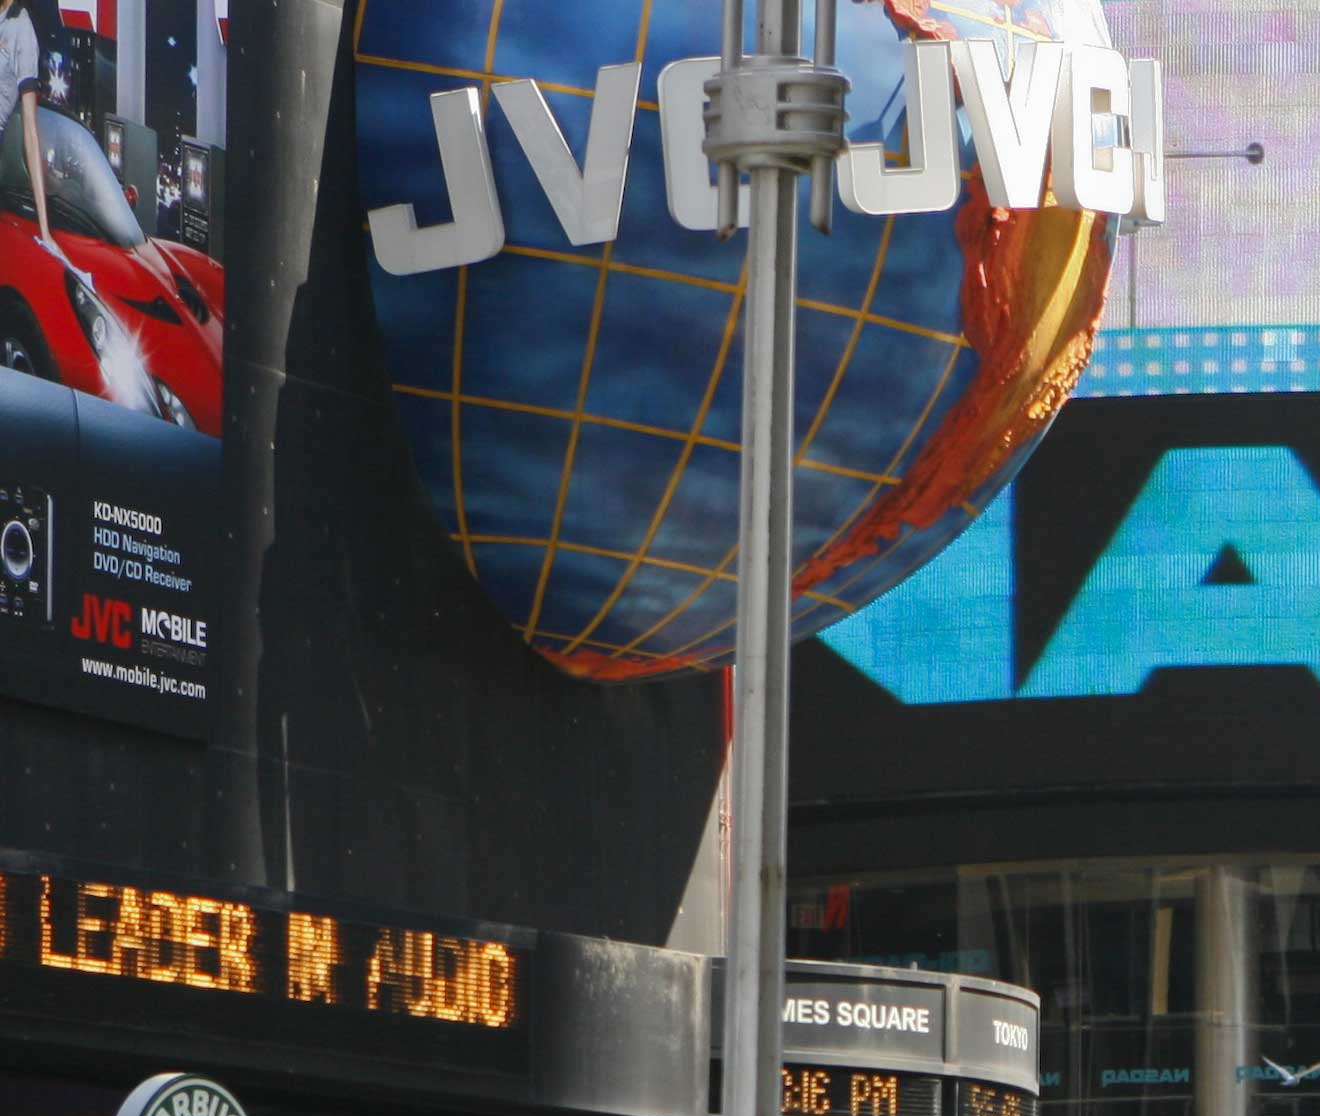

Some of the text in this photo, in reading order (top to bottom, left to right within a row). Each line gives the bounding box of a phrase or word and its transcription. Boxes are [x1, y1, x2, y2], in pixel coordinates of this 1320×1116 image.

[838, 39, 1135, 216] JVC
[93, 500, 162, 535] KD-NX5000
[94, 526, 181, 564] HDD Navigation
[93, 552, 192, 592] DVD/CD Receiver
[71, 593, 133, 648] JVC
[82, 656, 206, 699] www.mobile.jvc.com
[782, 999, 929, 1033] MES SQUARE
[993, 1020, 1028, 1050] TOKYO
